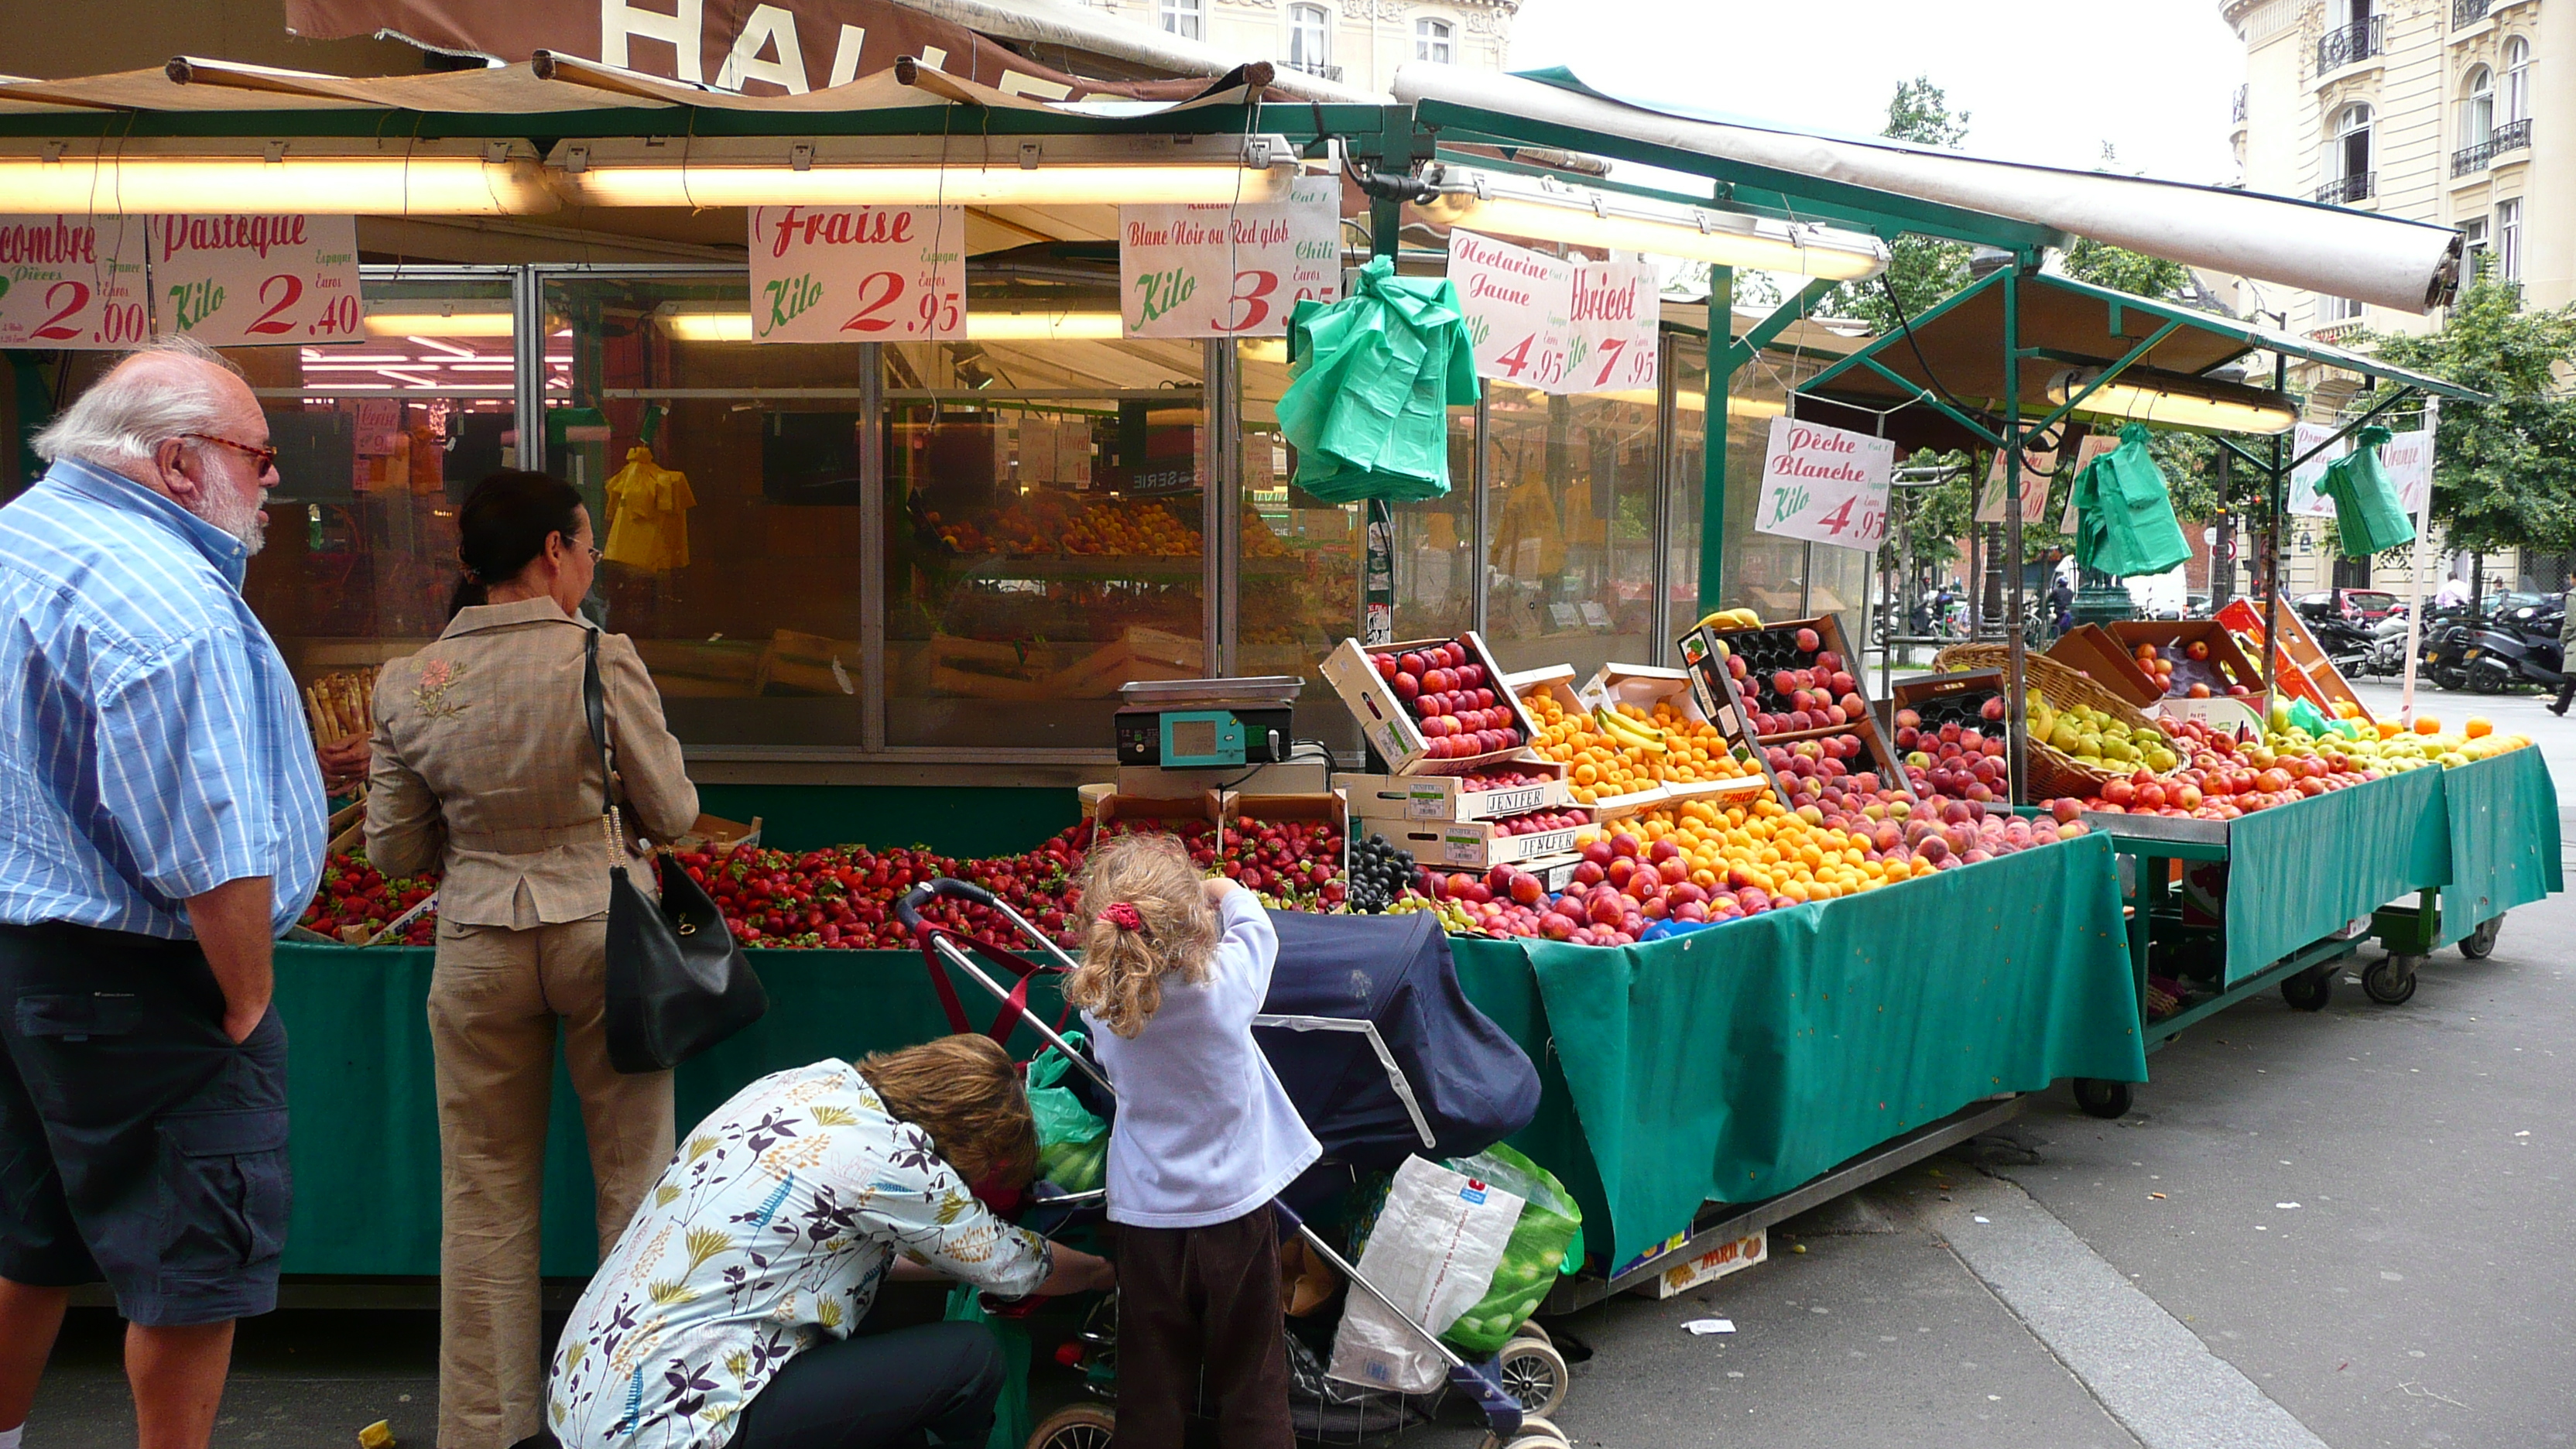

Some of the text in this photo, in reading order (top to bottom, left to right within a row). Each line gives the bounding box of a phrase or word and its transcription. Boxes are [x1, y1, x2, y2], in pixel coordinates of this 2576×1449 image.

[1290, 191, 1314, 203] Cat
[755, 205, 913, 257] Fraise
[1171, 221, 1204, 246] Noir
[1208, 230, 1224, 244] ou
[1228, 219, 1257, 244] Red
[1260, 218, 1288, 250] glob
[316, 249, 351, 266] Espagne
[920, 248, 957, 265] Espagne
[1296, 241, 1334, 259] Chili
[1455, 237, 1548, 280] Nectarine
[315, 272, 341, 289] Euros
[919, 271, 945, 287] Euros
[1293, 265, 1320, 282] Euros
[103, 281, 128, 296] Euros
[1131, 267, 1197, 331] Kilo
[1470, 272, 1530, 306] Jaune
[167, 277, 227, 336] Kilo
[759, 273, 824, 337] Kilo
[1463, 314, 1489, 349] ilo
[1563, 334, 1588, 379] ilo
[1787, 427, 1855, 454] Pêche
[1773, 454, 1865, 482] Blanche
[1766, 485, 1810, 529] Kilo
[1490, 790, 1540, 810] JENIFER
[1522, 834, 1572, 855] JENIFER
